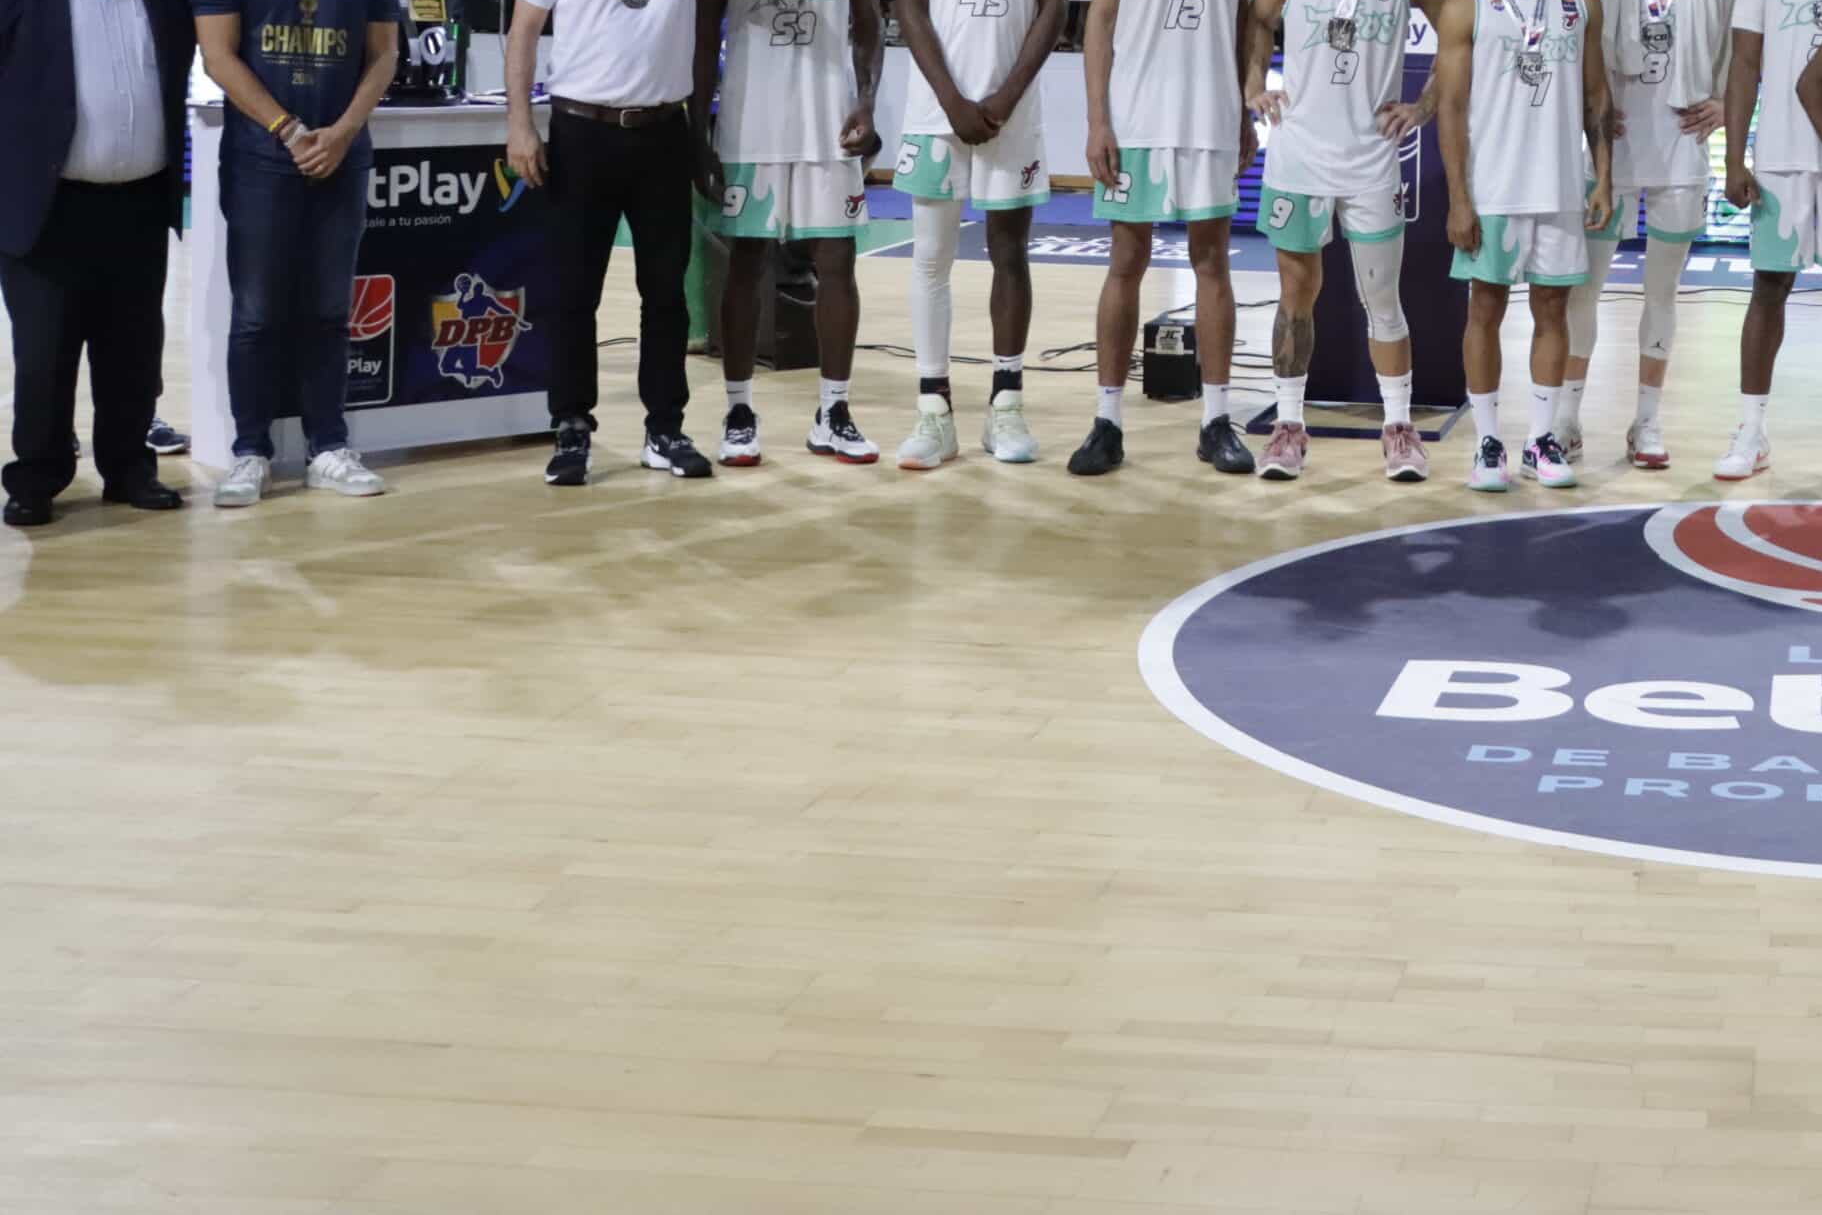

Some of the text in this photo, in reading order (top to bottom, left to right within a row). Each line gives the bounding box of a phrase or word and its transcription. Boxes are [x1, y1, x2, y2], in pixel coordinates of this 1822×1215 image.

[261, 23, 348, 56] CHAMPS
[769, 10, 817, 46] 59
[1330, 50, 1360, 85] 9
[1639, 50, 1671, 84] 8
[1525, 71, 1552, 107] 7
[367, 160, 487, 214] tPlay
[389, 219, 395, 227] a
[399, 216, 411, 227] tu
[414, 214, 451, 227] pasión
[1267, 196, 1295, 230] 9
[432, 316, 517, 348] DPB
[346, 357, 383, 378] Play
[1465, 744, 1610, 767] DE
